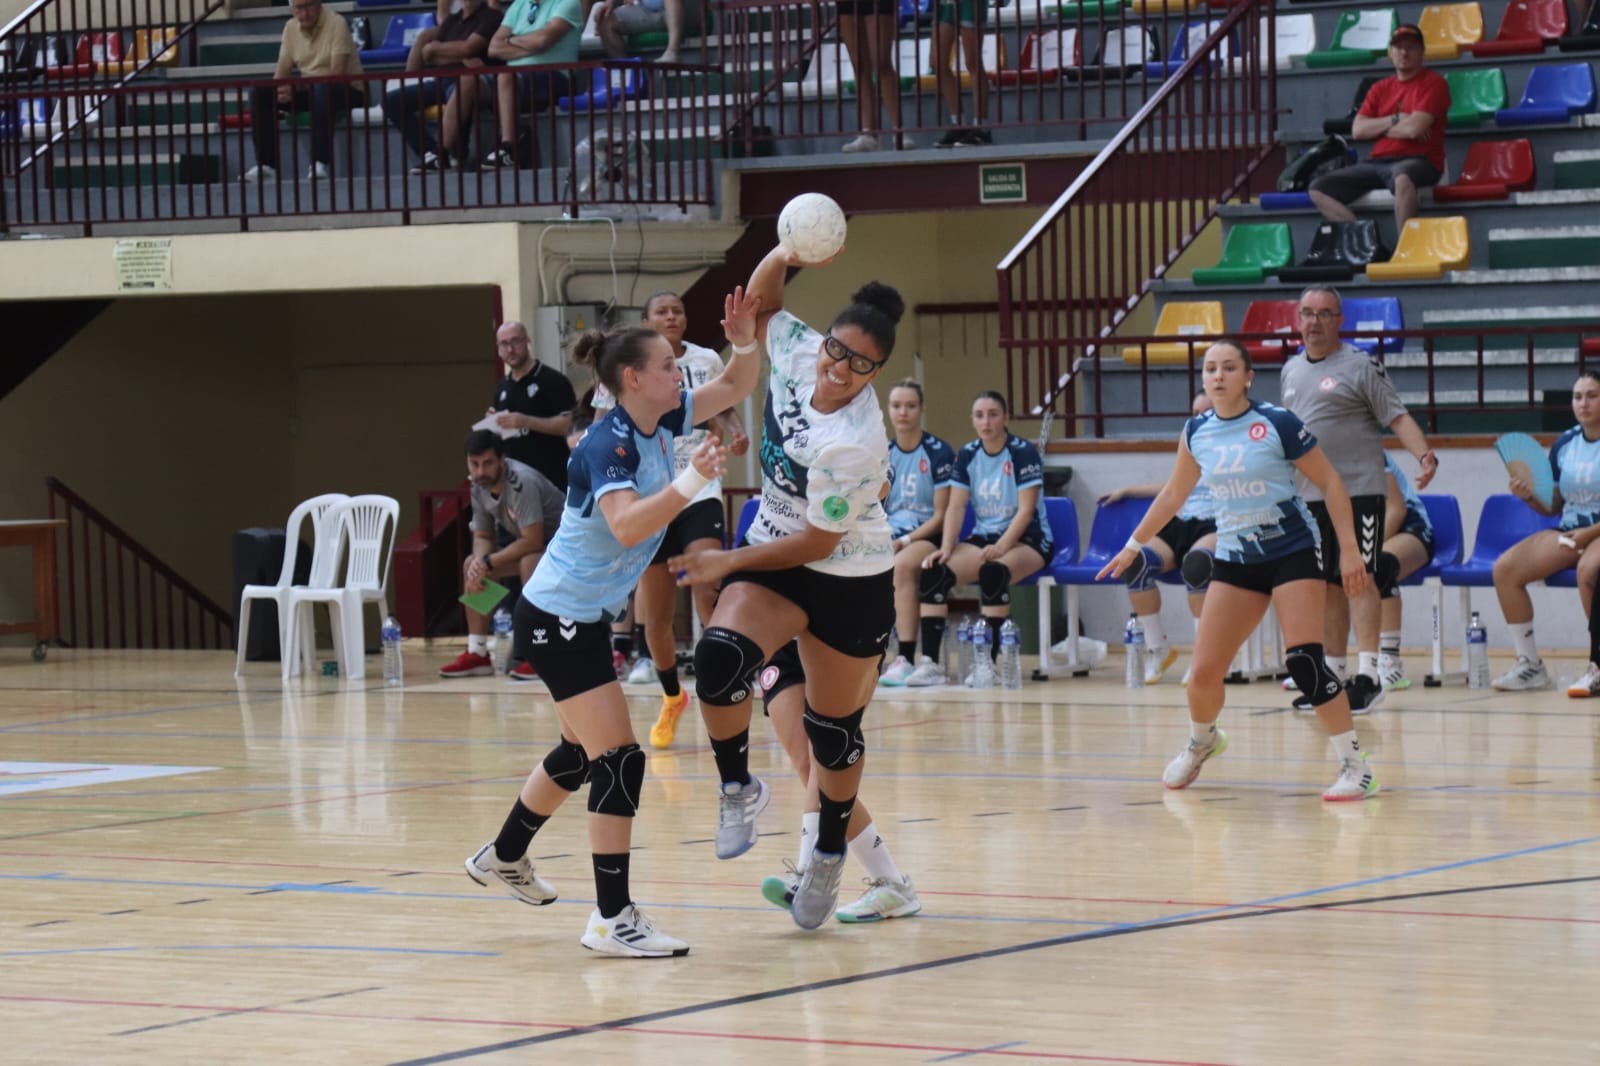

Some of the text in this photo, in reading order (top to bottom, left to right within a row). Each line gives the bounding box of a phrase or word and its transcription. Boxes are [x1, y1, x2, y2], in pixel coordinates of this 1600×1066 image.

[1212, 443, 1246, 475] 22
[900, 472, 917, 497] 15
[977, 478, 1002, 501] 44
